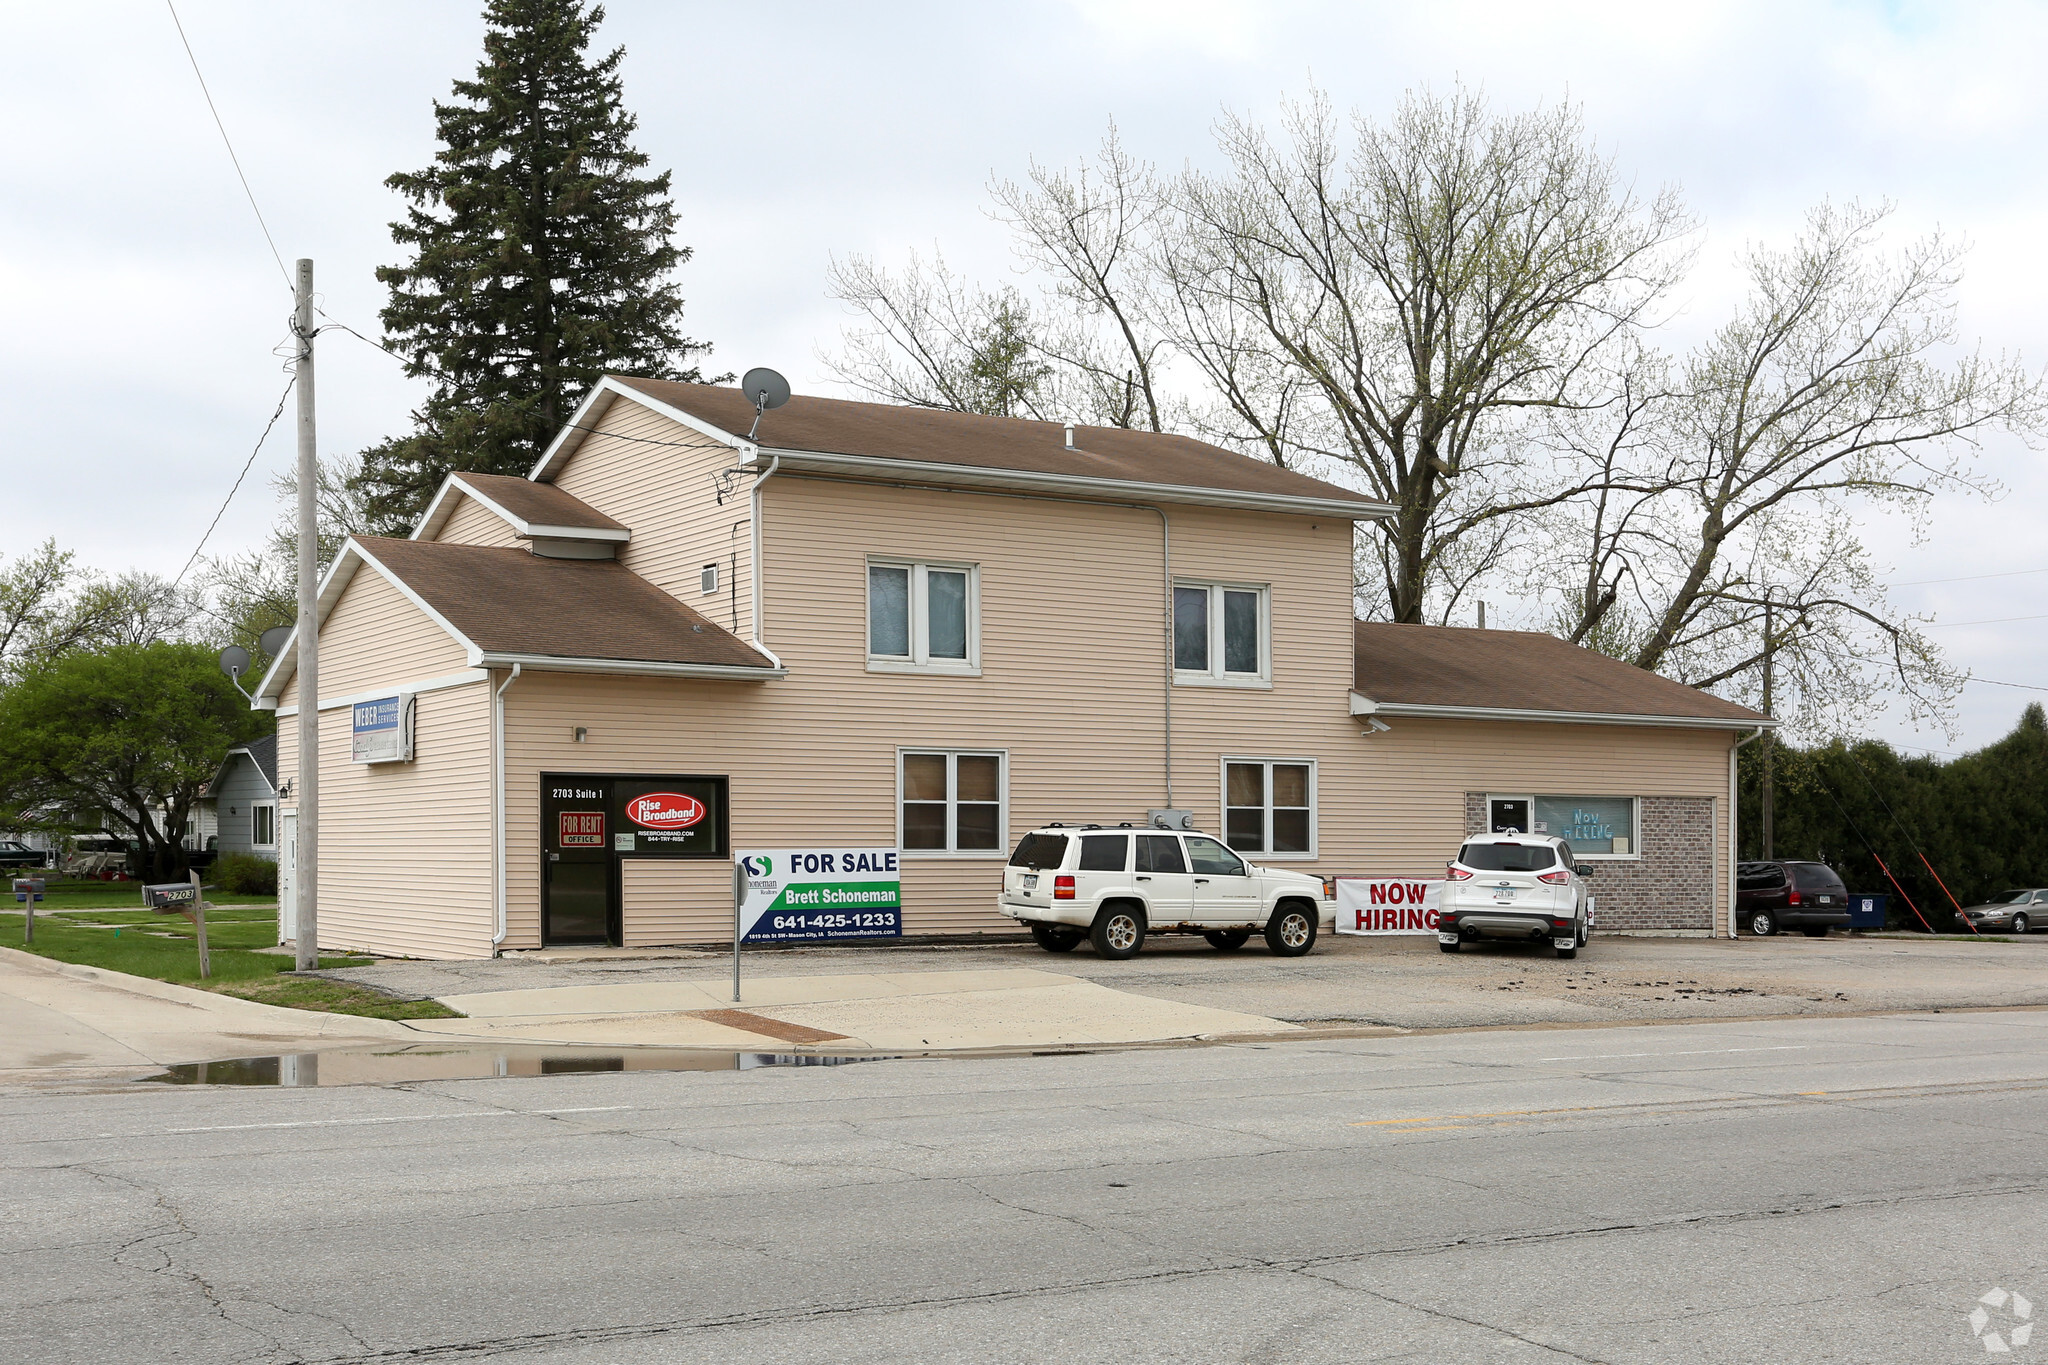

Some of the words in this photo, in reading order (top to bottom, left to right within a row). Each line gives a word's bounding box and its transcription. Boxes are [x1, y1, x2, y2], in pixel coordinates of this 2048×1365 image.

[355, 706, 378, 727] WEBER
[552, 788, 573, 798] 2703
[575, 788, 597, 799] Suite
[599, 789, 603, 799] 1
[638, 799, 661, 819] Rise
[643, 800, 695, 821] Broadband
[562, 816, 578, 833] FOR
[580, 816, 602, 833] RENT
[568, 835, 595, 843] OFFICE
[790, 854, 835, 874] FOR
[842, 853, 897, 873] SALE
[168, 890, 193, 900] 2703
[785, 889, 819, 905] Brett
[822, 888, 897, 904] Schoneman
[1370, 883, 1428, 904] NOW
[773, 913, 896, 930] 641-425-1233
[1355, 908, 1441, 930] HIRING
[827, 929, 896, 937] SchonemanRealtors.com
